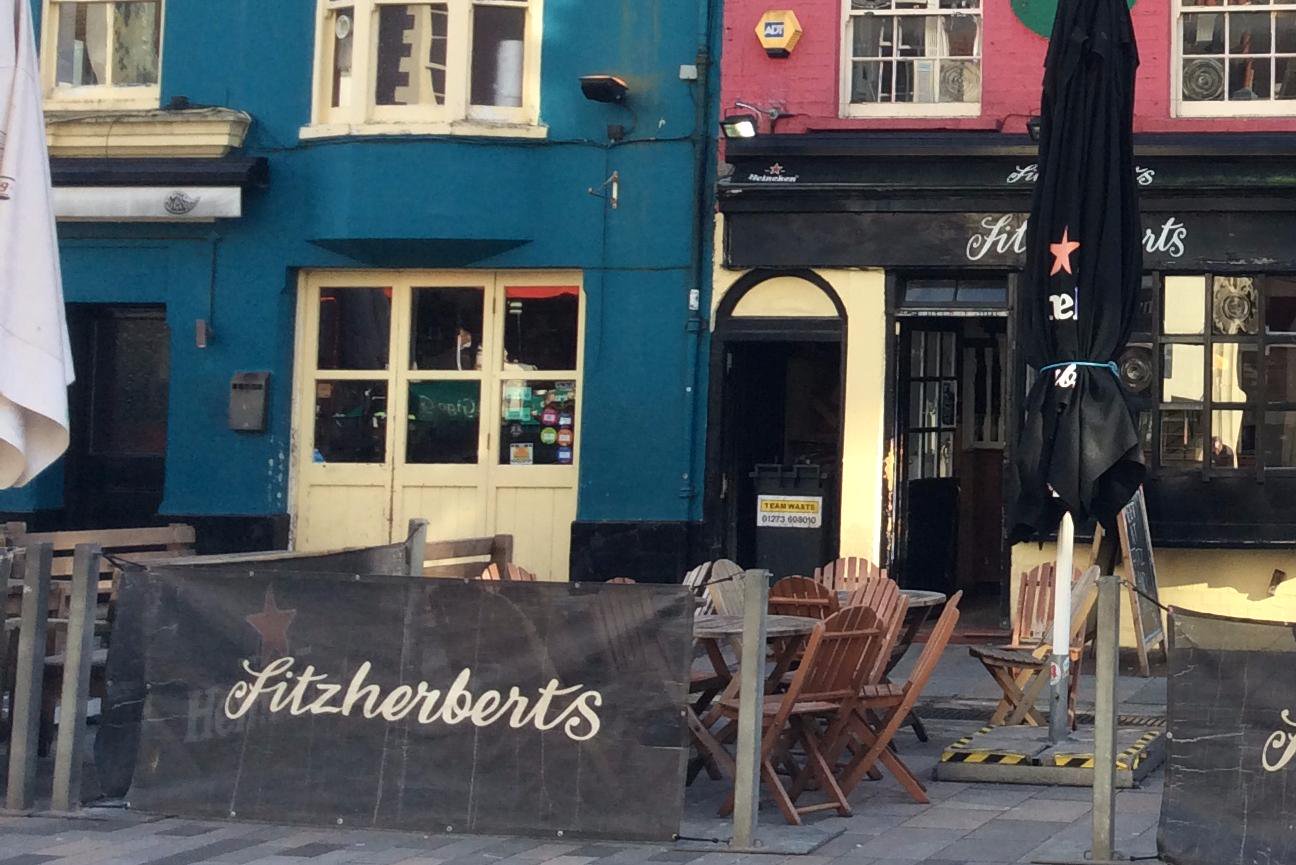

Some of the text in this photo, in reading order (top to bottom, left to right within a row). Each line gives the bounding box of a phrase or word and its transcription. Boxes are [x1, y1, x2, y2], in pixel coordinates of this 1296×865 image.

[765, 24, 784, 35] ADT
[787, 503, 816, 511] WASTE
[762, 514, 786, 523] 01273
[225, 657, 602, 741] Fitzherberts
